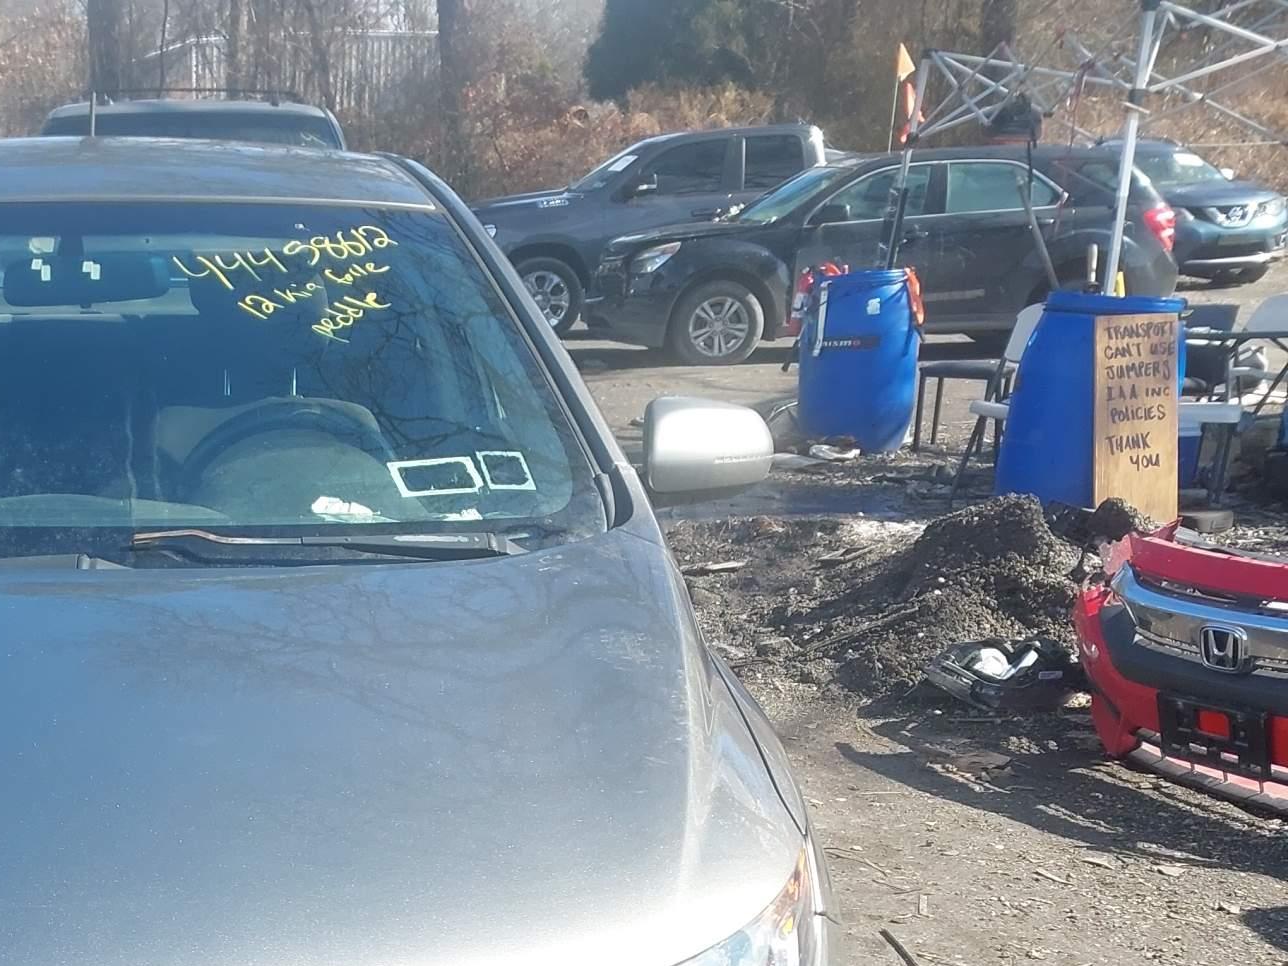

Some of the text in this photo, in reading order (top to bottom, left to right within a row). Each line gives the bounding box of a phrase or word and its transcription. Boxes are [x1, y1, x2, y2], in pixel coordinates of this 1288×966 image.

[1104, 321, 1175, 341] TRANSPORT
[1104, 341, 1175, 360] CAN'T USE
[1105, 361, 1171, 381] JUMPERS
[1105, 432, 1151, 456] THANK
